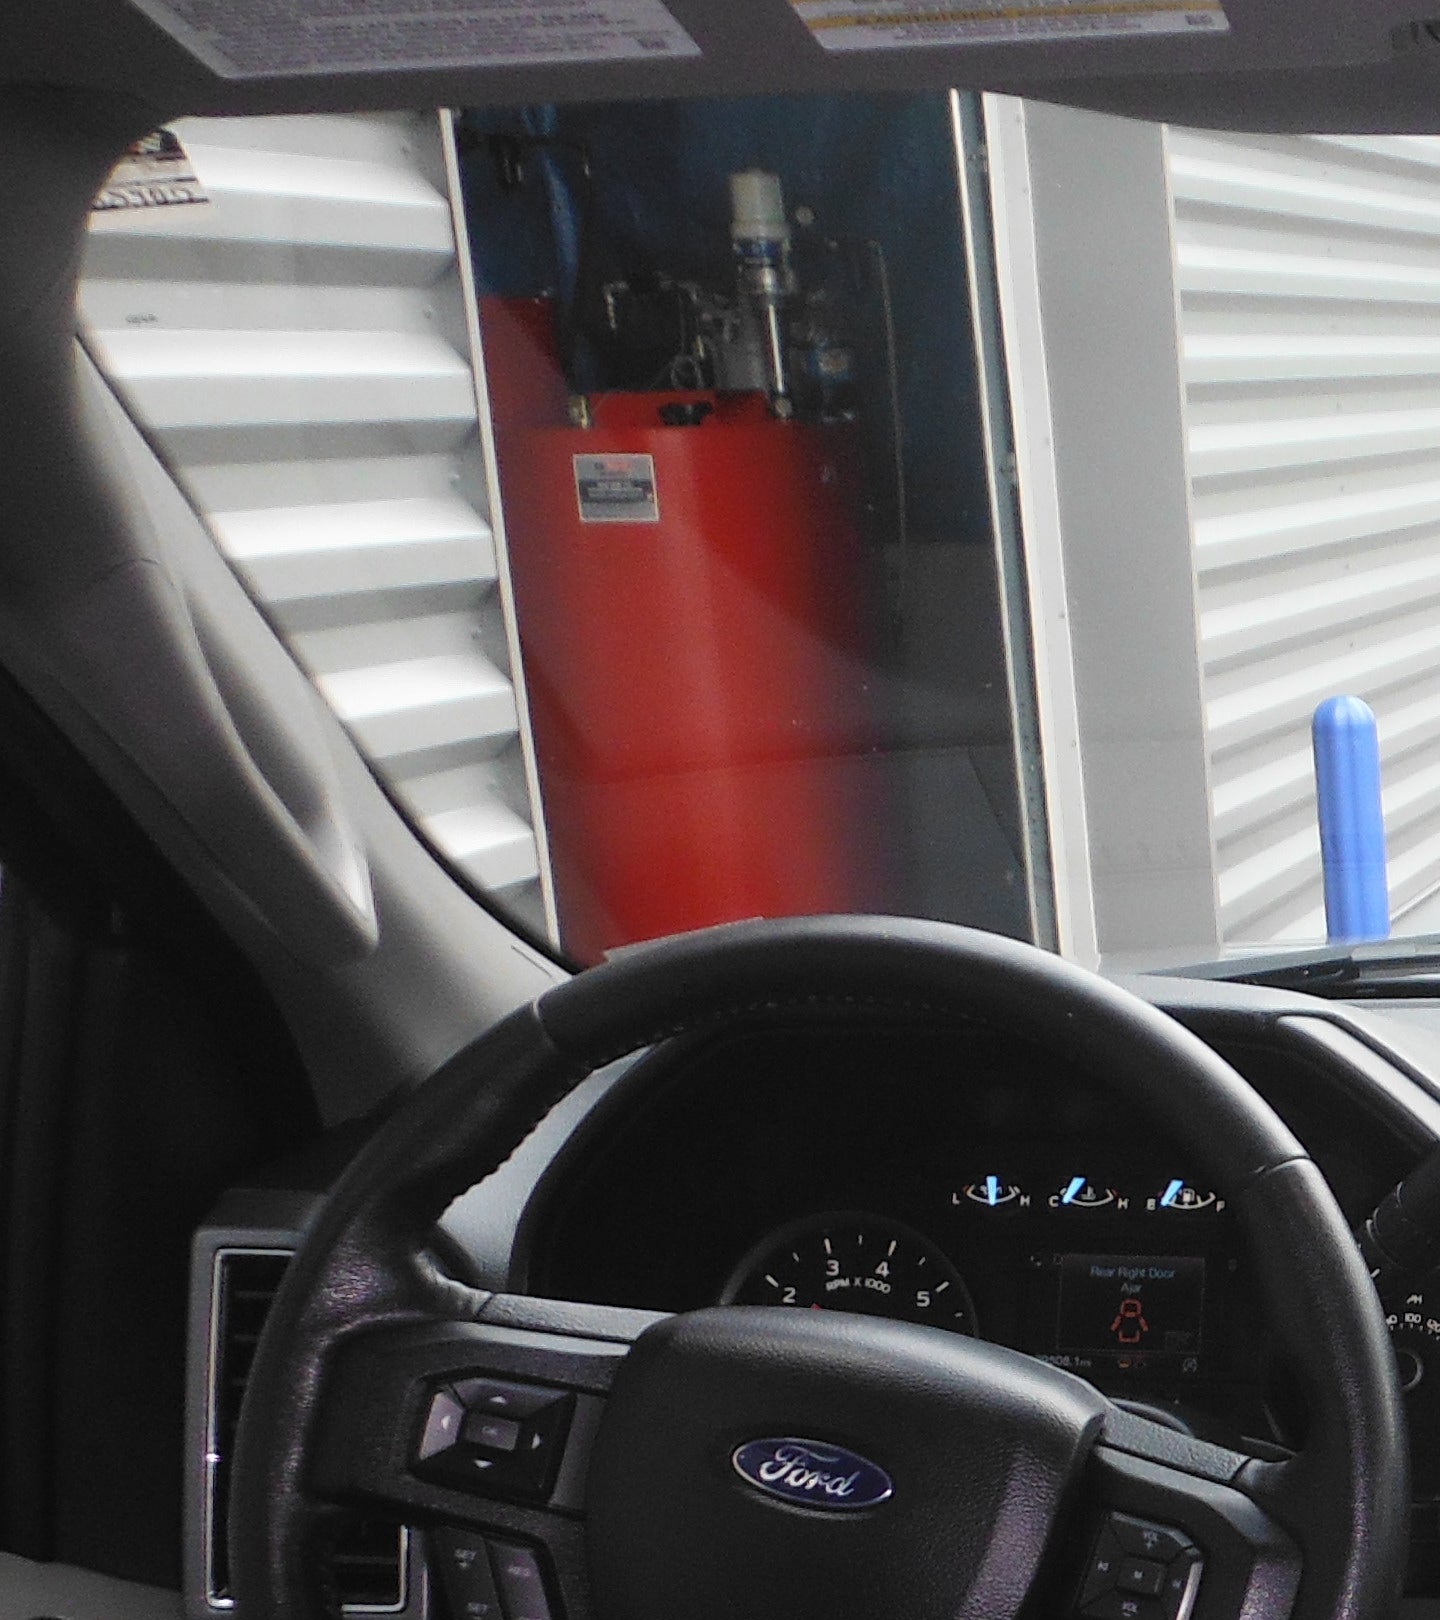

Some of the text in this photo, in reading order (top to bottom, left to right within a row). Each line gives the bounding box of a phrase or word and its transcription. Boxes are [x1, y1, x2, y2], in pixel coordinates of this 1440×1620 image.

[826, 1260, 839, 1276] 3
[875, 1261, 890, 1277] 4
[1090, 1265, 1176, 1281] Rear Right Door
[825, 1278, 850, 1291] RPM
[865, 1278, 891, 1294] 1000
[783, 1287, 796, 1304] 2
[916, 1291, 931, 1307] 5
[759, 1445, 861, 1496] Ford
